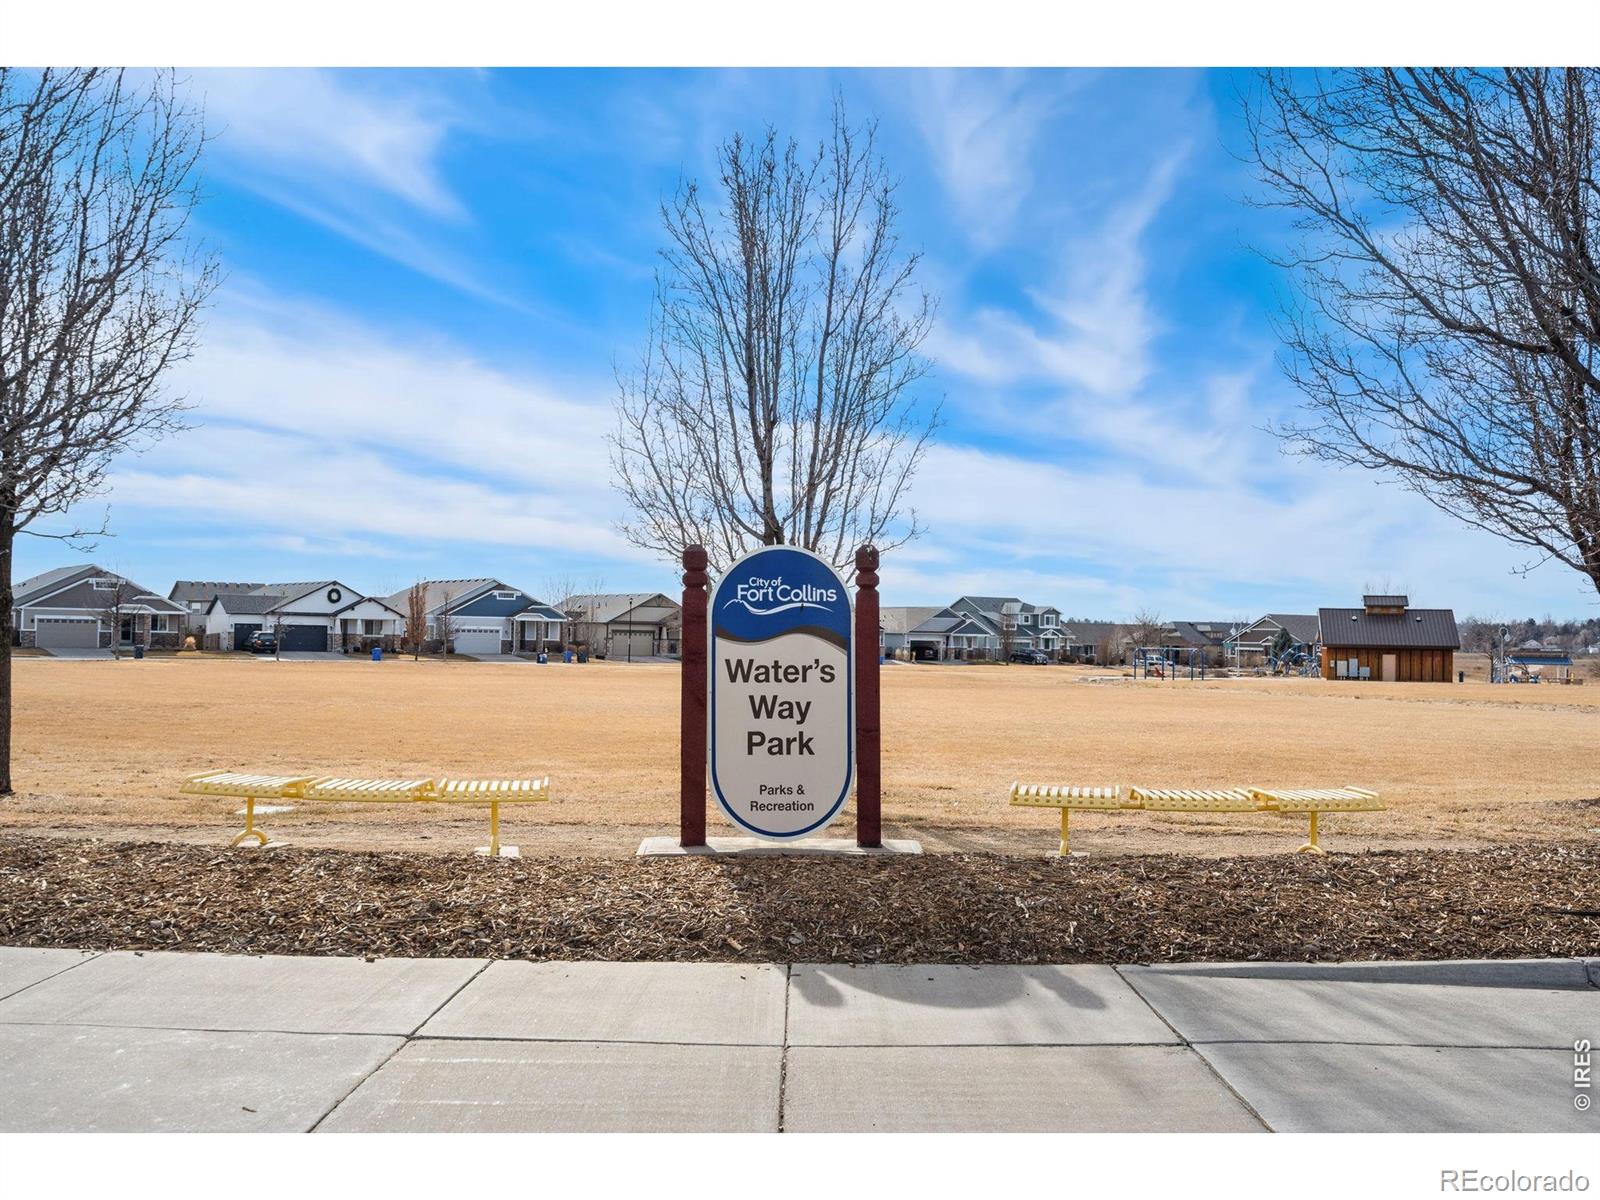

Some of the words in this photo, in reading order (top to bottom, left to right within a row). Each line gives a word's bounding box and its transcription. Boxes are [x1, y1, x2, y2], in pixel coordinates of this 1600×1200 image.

[749, 577, 769, 588] City
[771, 577, 782, 587] of
[737, 585, 774, 601] Fort
[776, 585, 837, 602] Collins
[725, 659, 836, 683] Water's
[749, 695, 811, 725] Way
[747, 731, 815, 756] Park
[759, 785, 793, 796] Parks
[796, 785, 805, 796] &
[750, 801, 815, 812] Recreation
